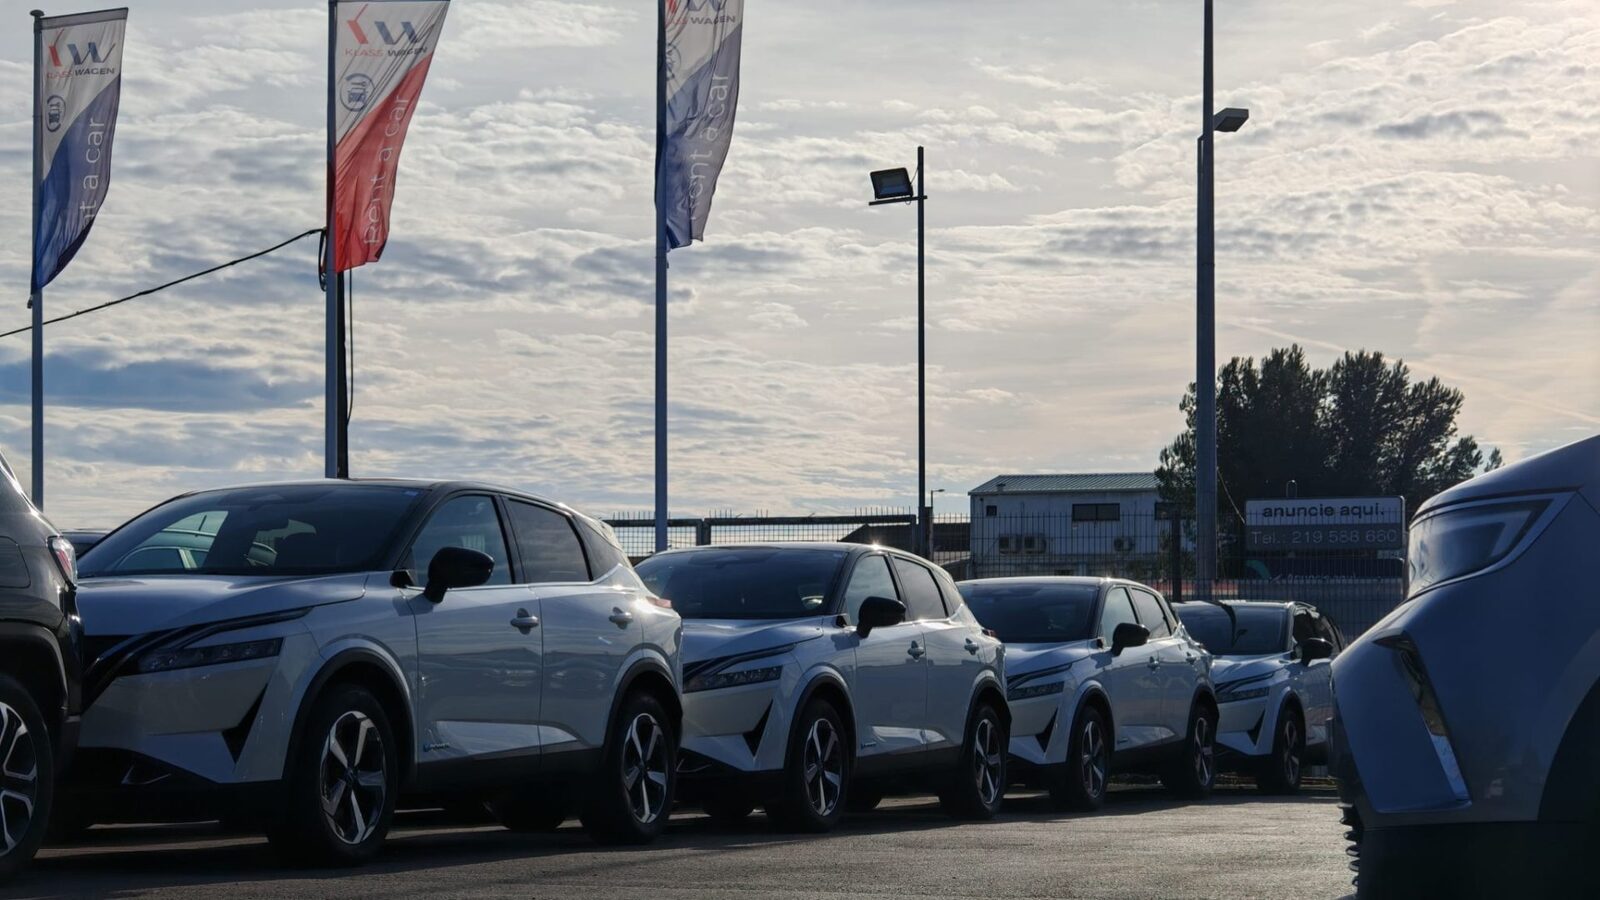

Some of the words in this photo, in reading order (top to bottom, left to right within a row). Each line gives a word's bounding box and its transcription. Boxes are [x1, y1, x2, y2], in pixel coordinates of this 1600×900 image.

[690, 15, 736, 25] WAGEN
[344, 48, 384, 56] KLASS
[74, 67, 115, 77] WAGEN
[707, 73, 729, 118] car
[385, 93, 410, 138] car
[85, 117, 105, 164] car
[699, 126, 719, 142] a
[379, 147, 394, 162] a
[83, 174, 99, 190] a
[1262, 504, 1334, 518] anuncie
[1292, 530, 1323, 543] 219
